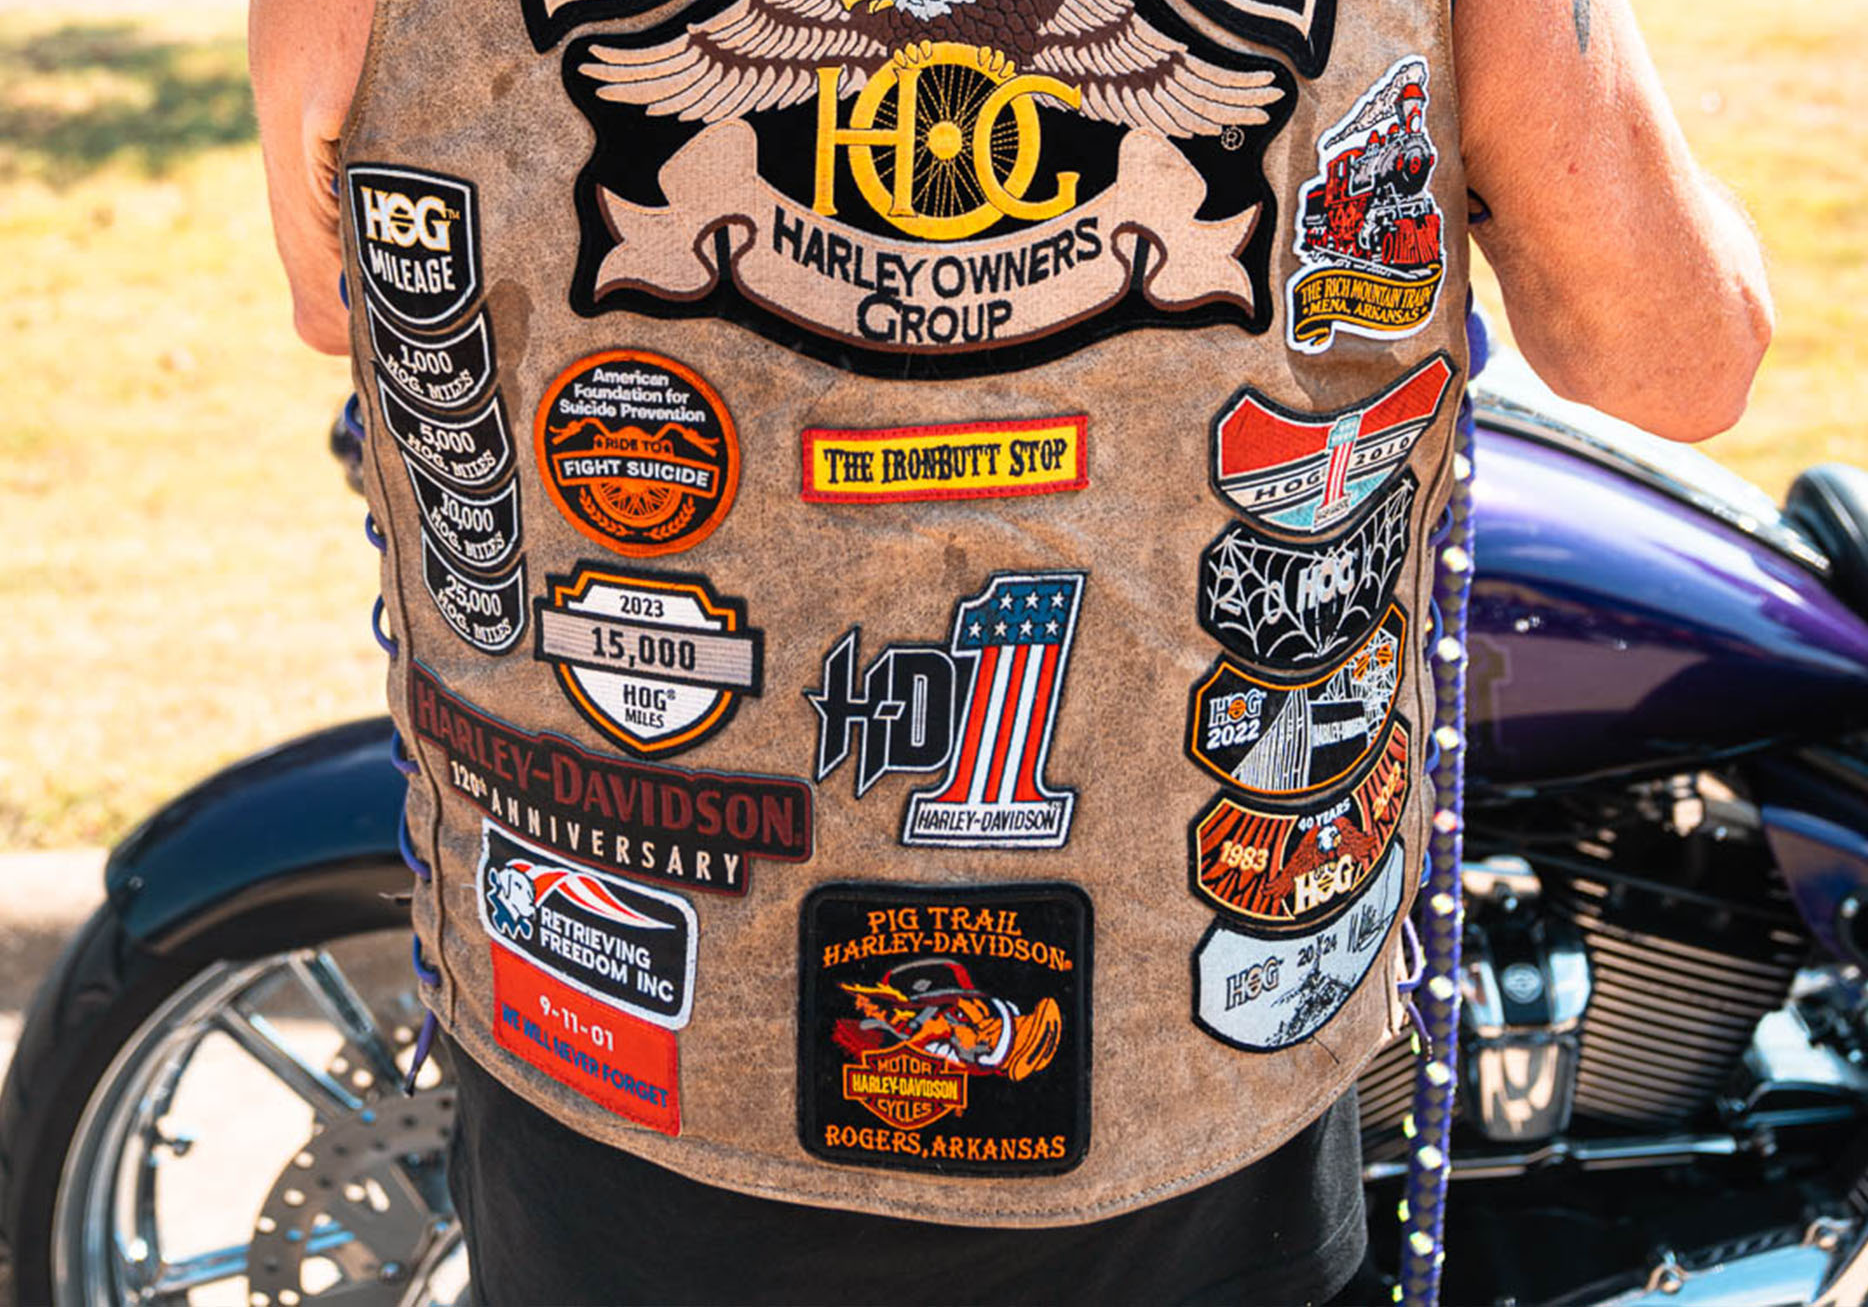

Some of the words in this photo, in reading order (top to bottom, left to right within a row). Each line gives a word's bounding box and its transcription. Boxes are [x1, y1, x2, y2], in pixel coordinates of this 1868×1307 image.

[811, 40, 1083, 241] HOG
[368, 242, 456, 294] MILEAGE
[772, 204, 929, 298] HARLEY
[931, 215, 1103, 300] OWNERS
[1301, 279, 1324, 305] THE
[1324, 277, 1351, 298] RICH
[1351, 278, 1402, 308] MOUNTAIN
[856, 292, 1013, 344] GROUP
[1353, 302, 1420, 324] ARKANSAS
[400, 344, 453, 375] 1,000
[426, 368, 474, 401] MILES
[592, 368, 669, 387] American
[574, 383, 663, 404] Foundation
[665, 389, 690, 405] for
[559, 398, 617, 418] Suicide
[620, 403, 706, 423] Prevention
[419, 422, 476, 453] 5,000
[605, 438, 638, 451] RIDE
[642, 440, 662, 453] TO
[450, 449, 496, 479] MILES
[563, 459, 622, 477] FIGHT
[626, 460, 710, 488] SUICIDE
[823, 446, 874, 485] THE
[881, 442, 1002, 484] IRONBUTT
[1008, 437, 1068, 477] STOP
[1254, 468, 1320, 503] HOG
[1354, 436, 1410, 467] 2010
[440, 492, 494, 533] 10,000
[464, 530, 505, 560] MILES
[445, 574, 502, 616] 25,000
[1297, 548, 1356, 613] HOG
[620, 594, 665, 618] 2023
[473, 617, 512, 643] MILES
[591, 626, 696, 671] 15,000
[624, 708, 665, 729] MILES
[805, 627, 957, 800] H-D
[1208, 688, 1264, 728] HOG
[1206, 719, 1261, 750] 2022
[416, 679, 796, 848] HARLEY-DAVIDSON
[917, 806, 1057, 833] HARLEY-DAVIDSON
[1314, 797, 1351, 826] YEARS
[490, 784, 741, 886] ANNIVERSARY
[1219, 840, 1269, 872] 1983
[1293, 854, 1354, 915] HOG
[867, 906, 920, 934] PIG
[927, 906, 1022, 936] TRAIL
[540, 906, 652, 969] RETRIEVING
[823, 932, 1068, 972] HARLEY-DAVIDSON
[539, 926, 628, 985] FREEDOM
[636, 969, 675, 1003] INC
[539, 994, 615, 1052] 9-11-01
[501, 1001, 521, 1033] WE
[522, 1016, 553, 1052] WILL
[553, 1032, 600, 1079] NEVER
[602, 1060, 669, 1109] FORGET
[877, 1054, 932, 1075] MOTOR
[852, 1073, 958, 1101] HARLEY-DAVIDSON
[877, 1098, 932, 1123] CYCLES
